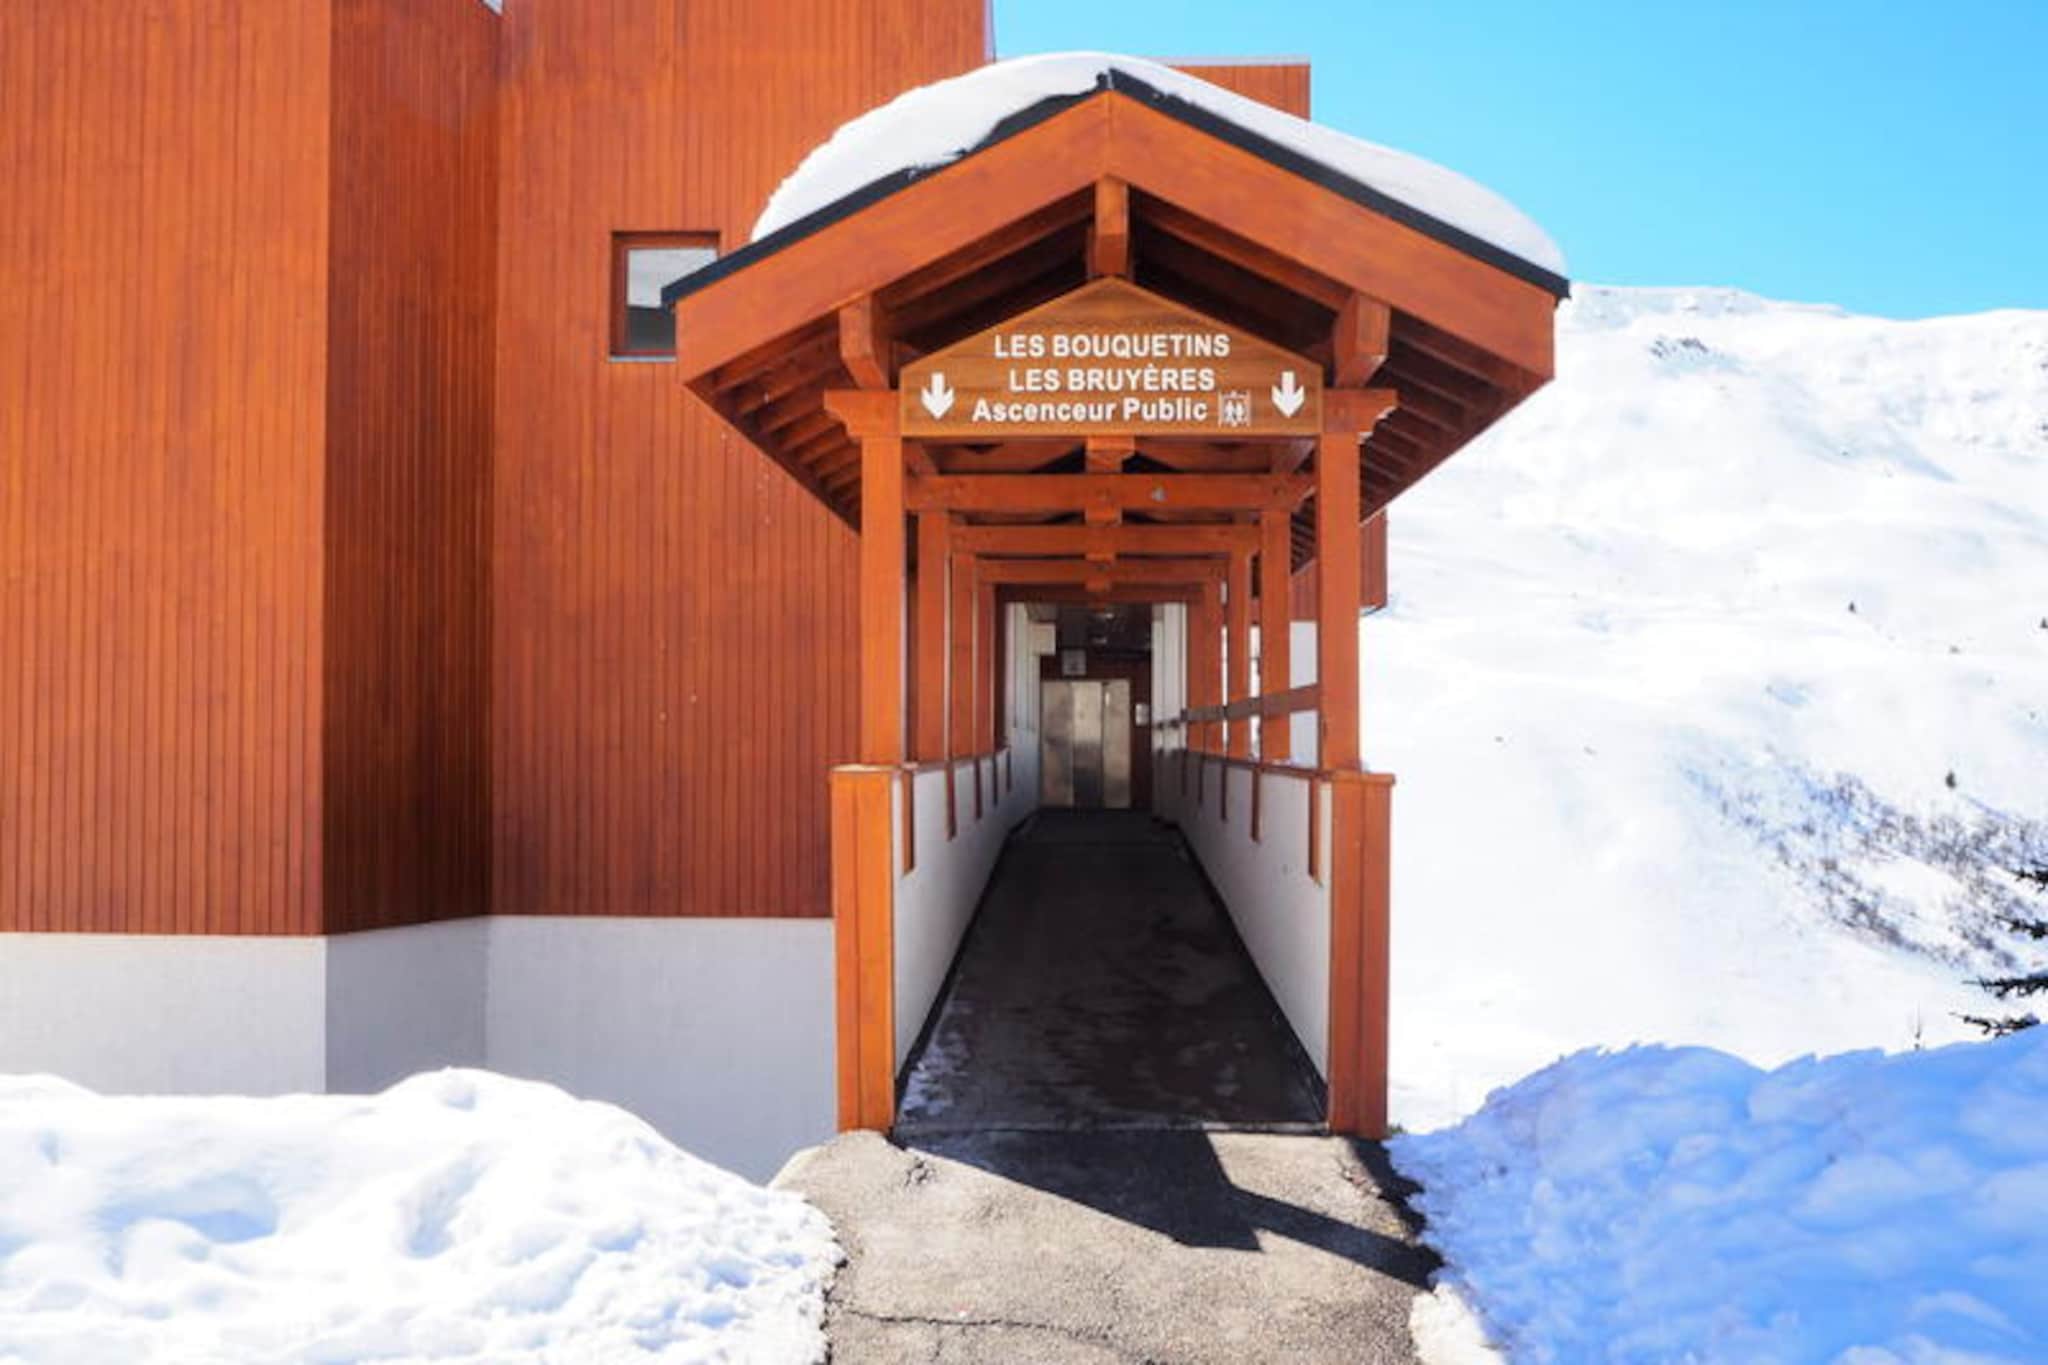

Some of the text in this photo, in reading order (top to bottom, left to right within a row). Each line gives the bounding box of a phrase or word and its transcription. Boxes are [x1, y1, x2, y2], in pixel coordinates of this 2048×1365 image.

[994, 334, 1231, 358] LES BOUQUETINS
[1009, 363, 1215, 392] LES BRUYÈRES
[972, 398, 1208, 422] Ascenceur Public
